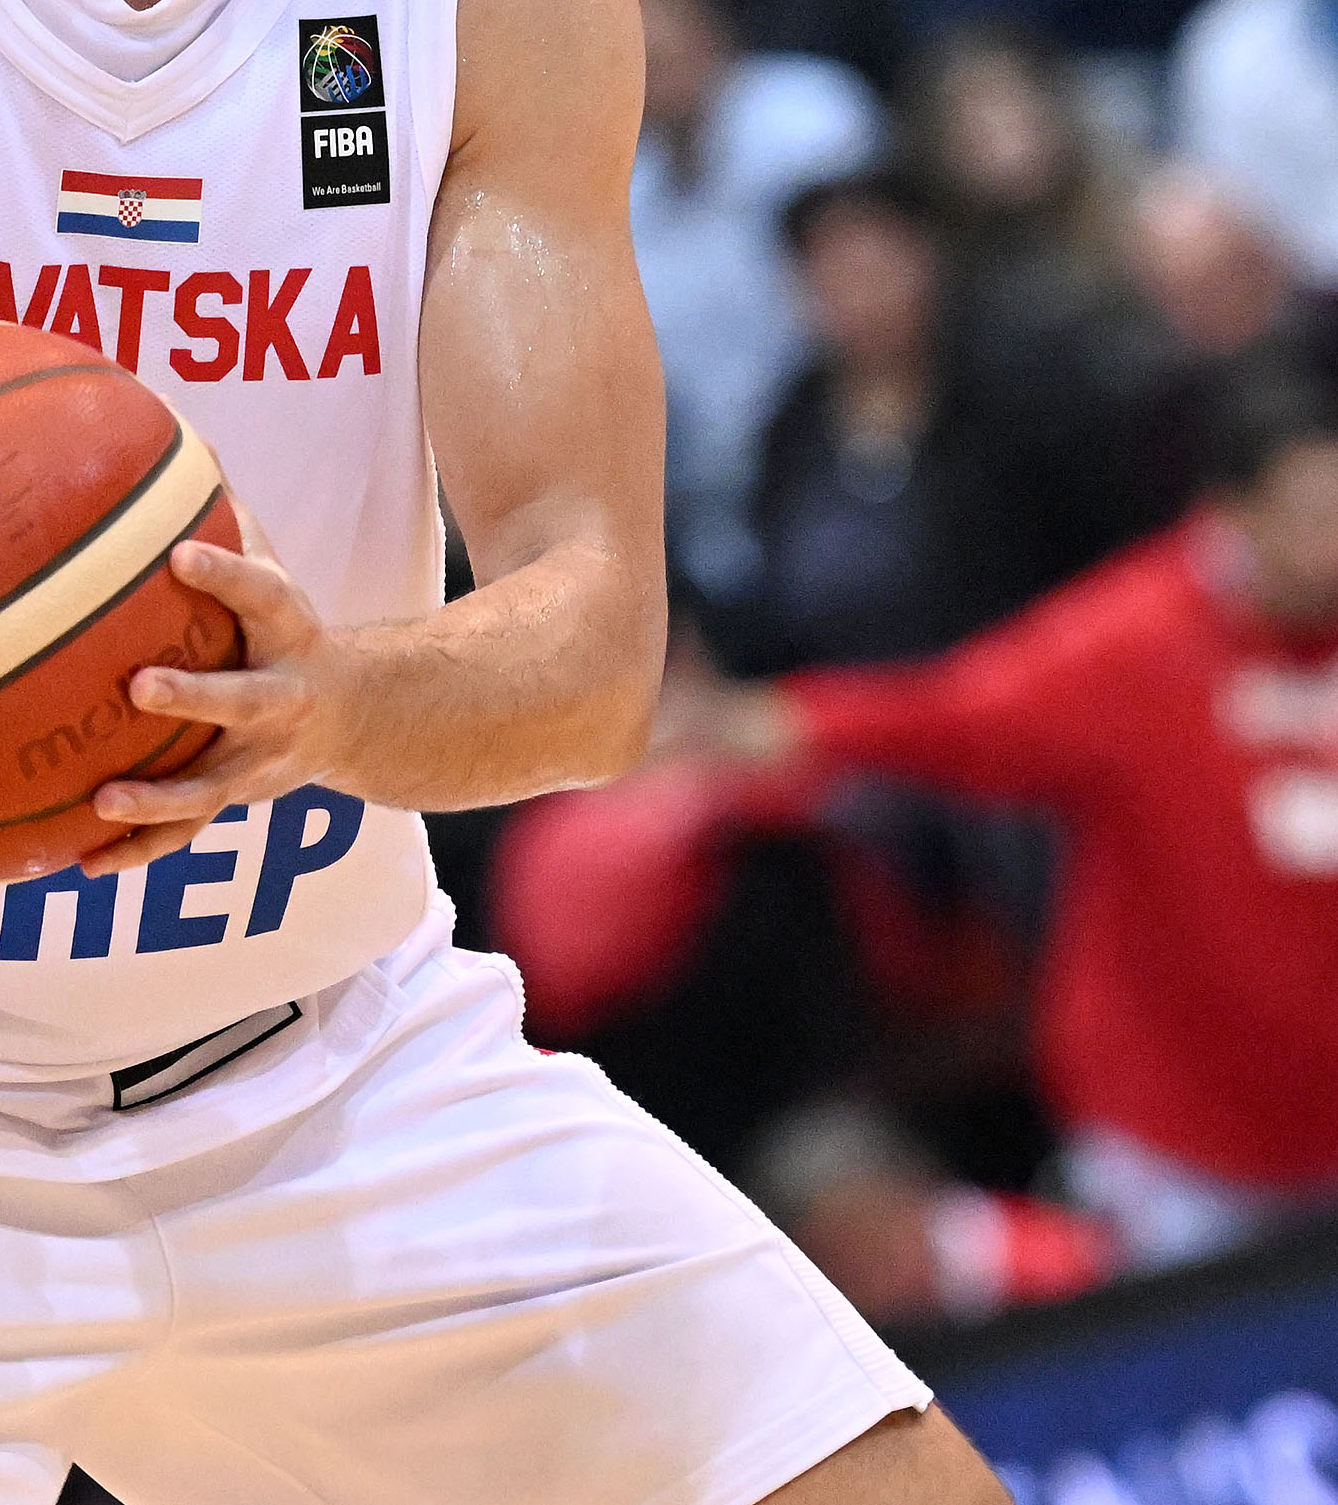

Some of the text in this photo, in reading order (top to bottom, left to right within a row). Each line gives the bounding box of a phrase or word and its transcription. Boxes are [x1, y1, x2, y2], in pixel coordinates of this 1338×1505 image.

[313, 125, 374, 159] FIBA
[311, 181, 382, 197] We Are Basketball
